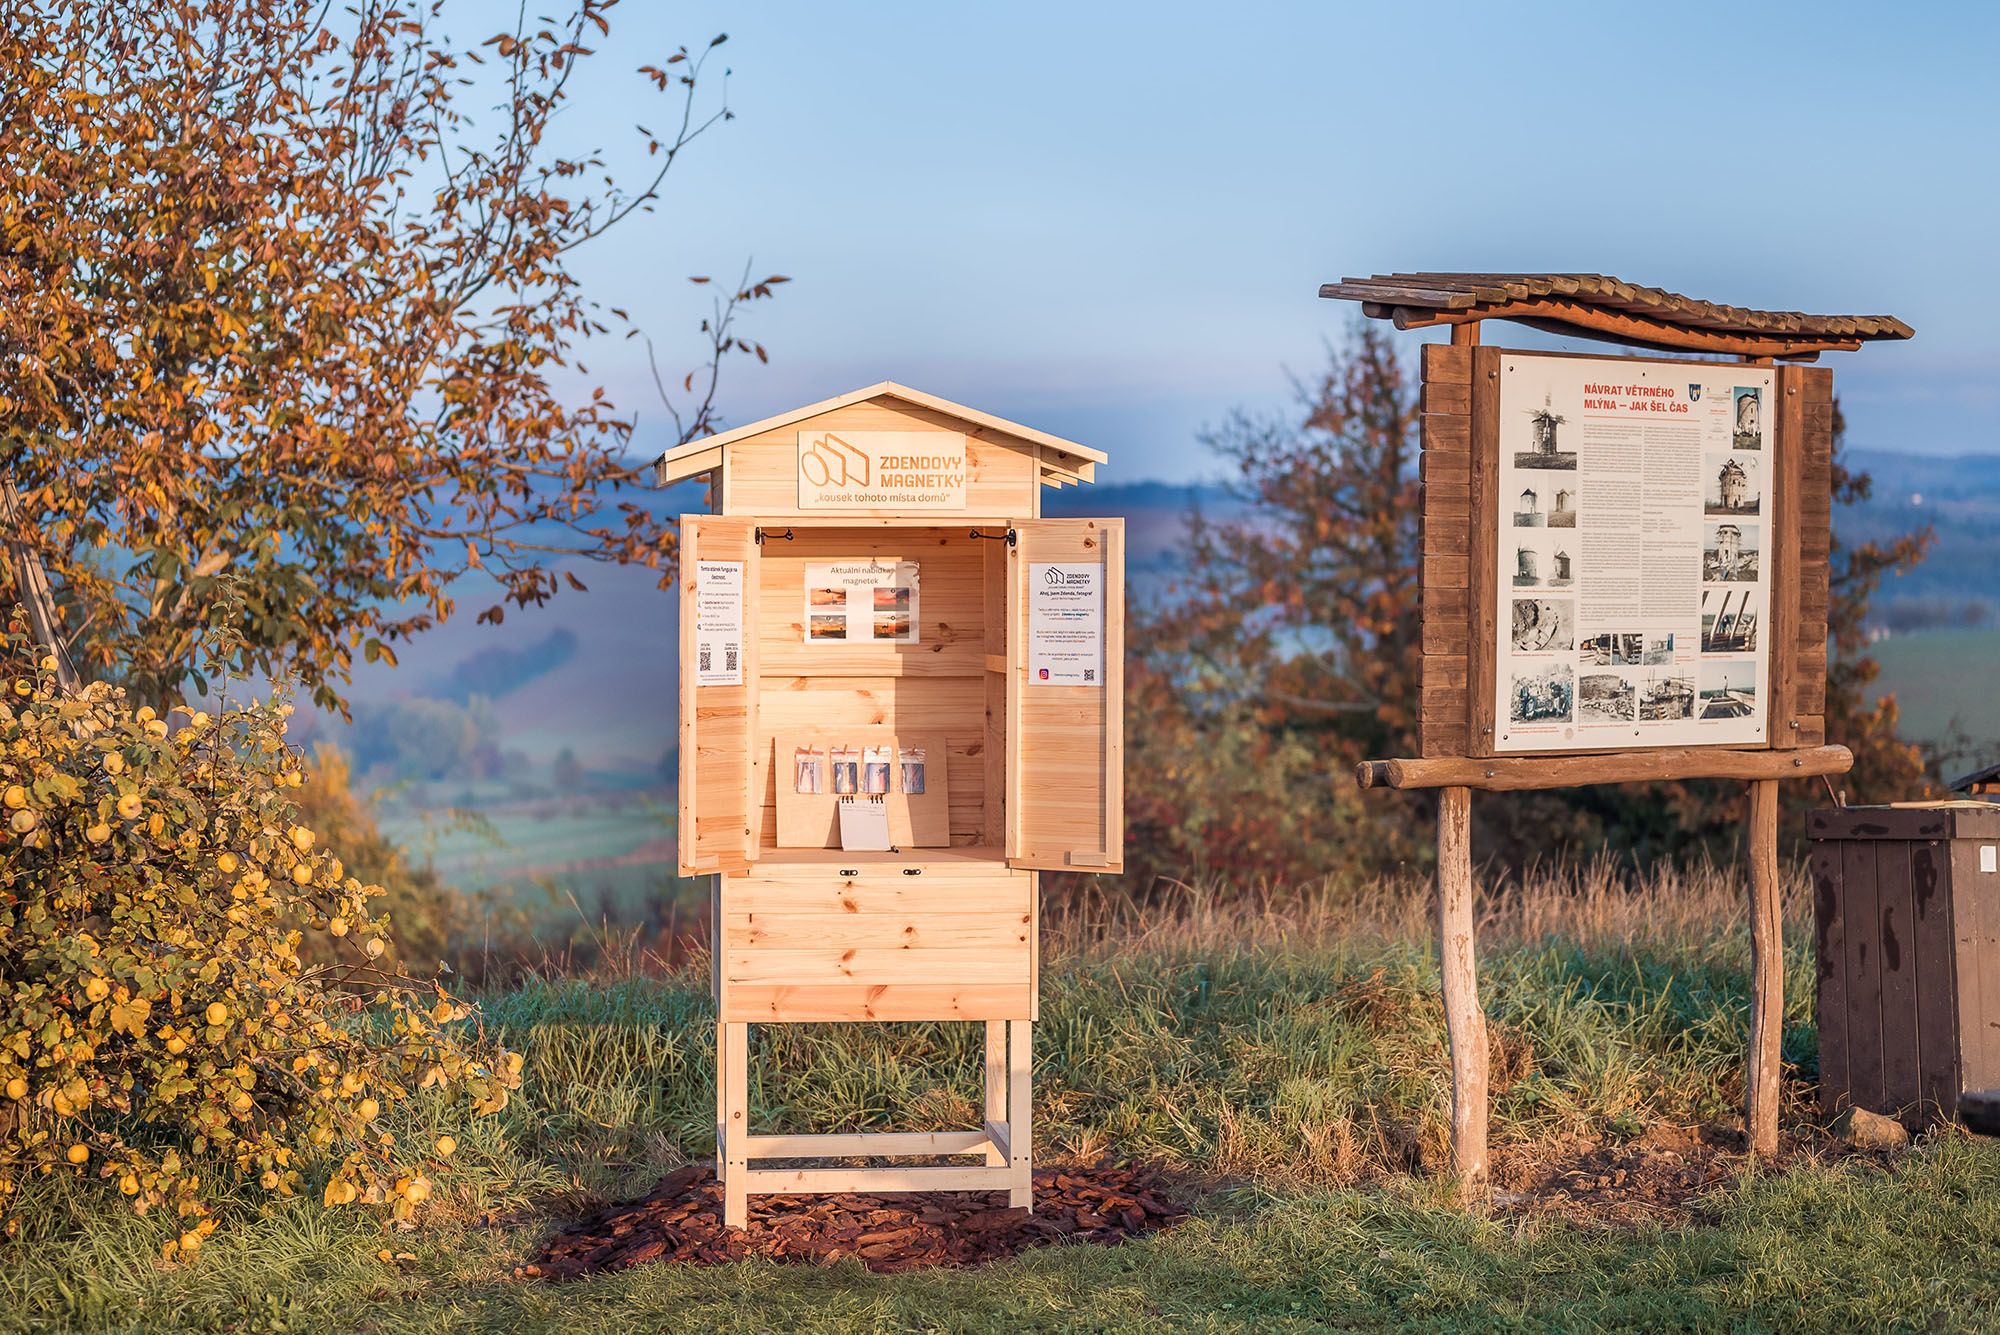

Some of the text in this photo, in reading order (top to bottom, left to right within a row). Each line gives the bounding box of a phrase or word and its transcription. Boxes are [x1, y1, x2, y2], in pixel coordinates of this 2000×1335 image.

[1584, 382, 1674, 398] NÁVRAT VĚTRNÉHO
[1584, 398, 1617, 410] MLÝNA
[1629, 401, 1648, 411] JAK
[1650, 400, 1667, 412] ŠEL
[1669, 401, 1689, 413] ČAS
[879, 456, 962, 470] ZDENDOVY
[880, 474, 964, 488] MAGNETKY
[854, 493, 888, 502] tohoto
[889, 493, 917, 502] místa
[842, 578, 879, 586] magnetek
